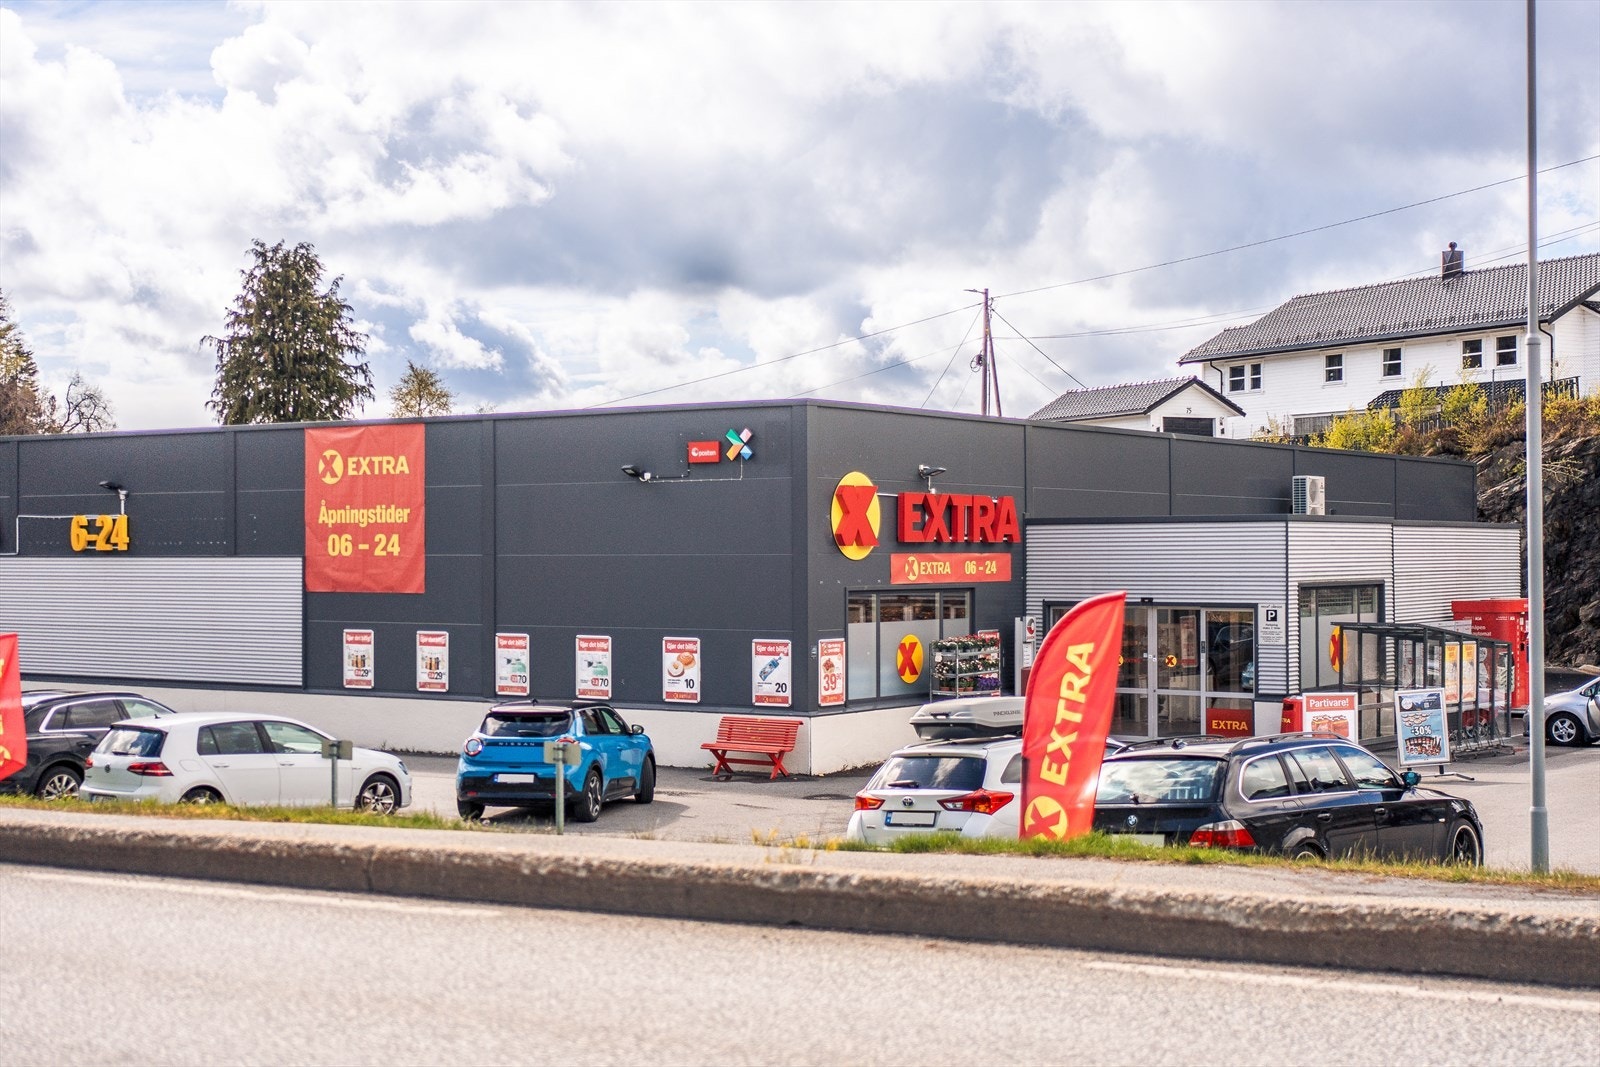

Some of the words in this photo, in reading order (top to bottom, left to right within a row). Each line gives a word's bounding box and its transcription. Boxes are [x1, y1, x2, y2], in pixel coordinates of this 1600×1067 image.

[347, 455, 410, 475] EXTRA
[318, 499, 410, 528] Åpningstider
[834, 484, 880, 547] X
[897, 492, 1021, 543] EXTRA
[70, 515, 129, 551] 6-24
[327, 533, 353, 557] 06
[373, 533, 401, 556] 24
[920, 561, 951, 575] EXTRA
[964, 560, 976, 575] 06
[985, 560, 997, 574] 24
[1267, 610, 1276, 621] P
[898, 642, 918, 676] X
[599, 677, 609, 687] 70
[684, 678, 695, 689] 10
[775, 682, 787, 693] 20
[823, 673, 836, 691] 39
[1309, 698, 1349, 708] Partivare!
[1039, 642, 1094, 786] EXTRA
[1211, 719, 1249, 731] EXTRA
[1411, 725, 1432, 736] -30%
